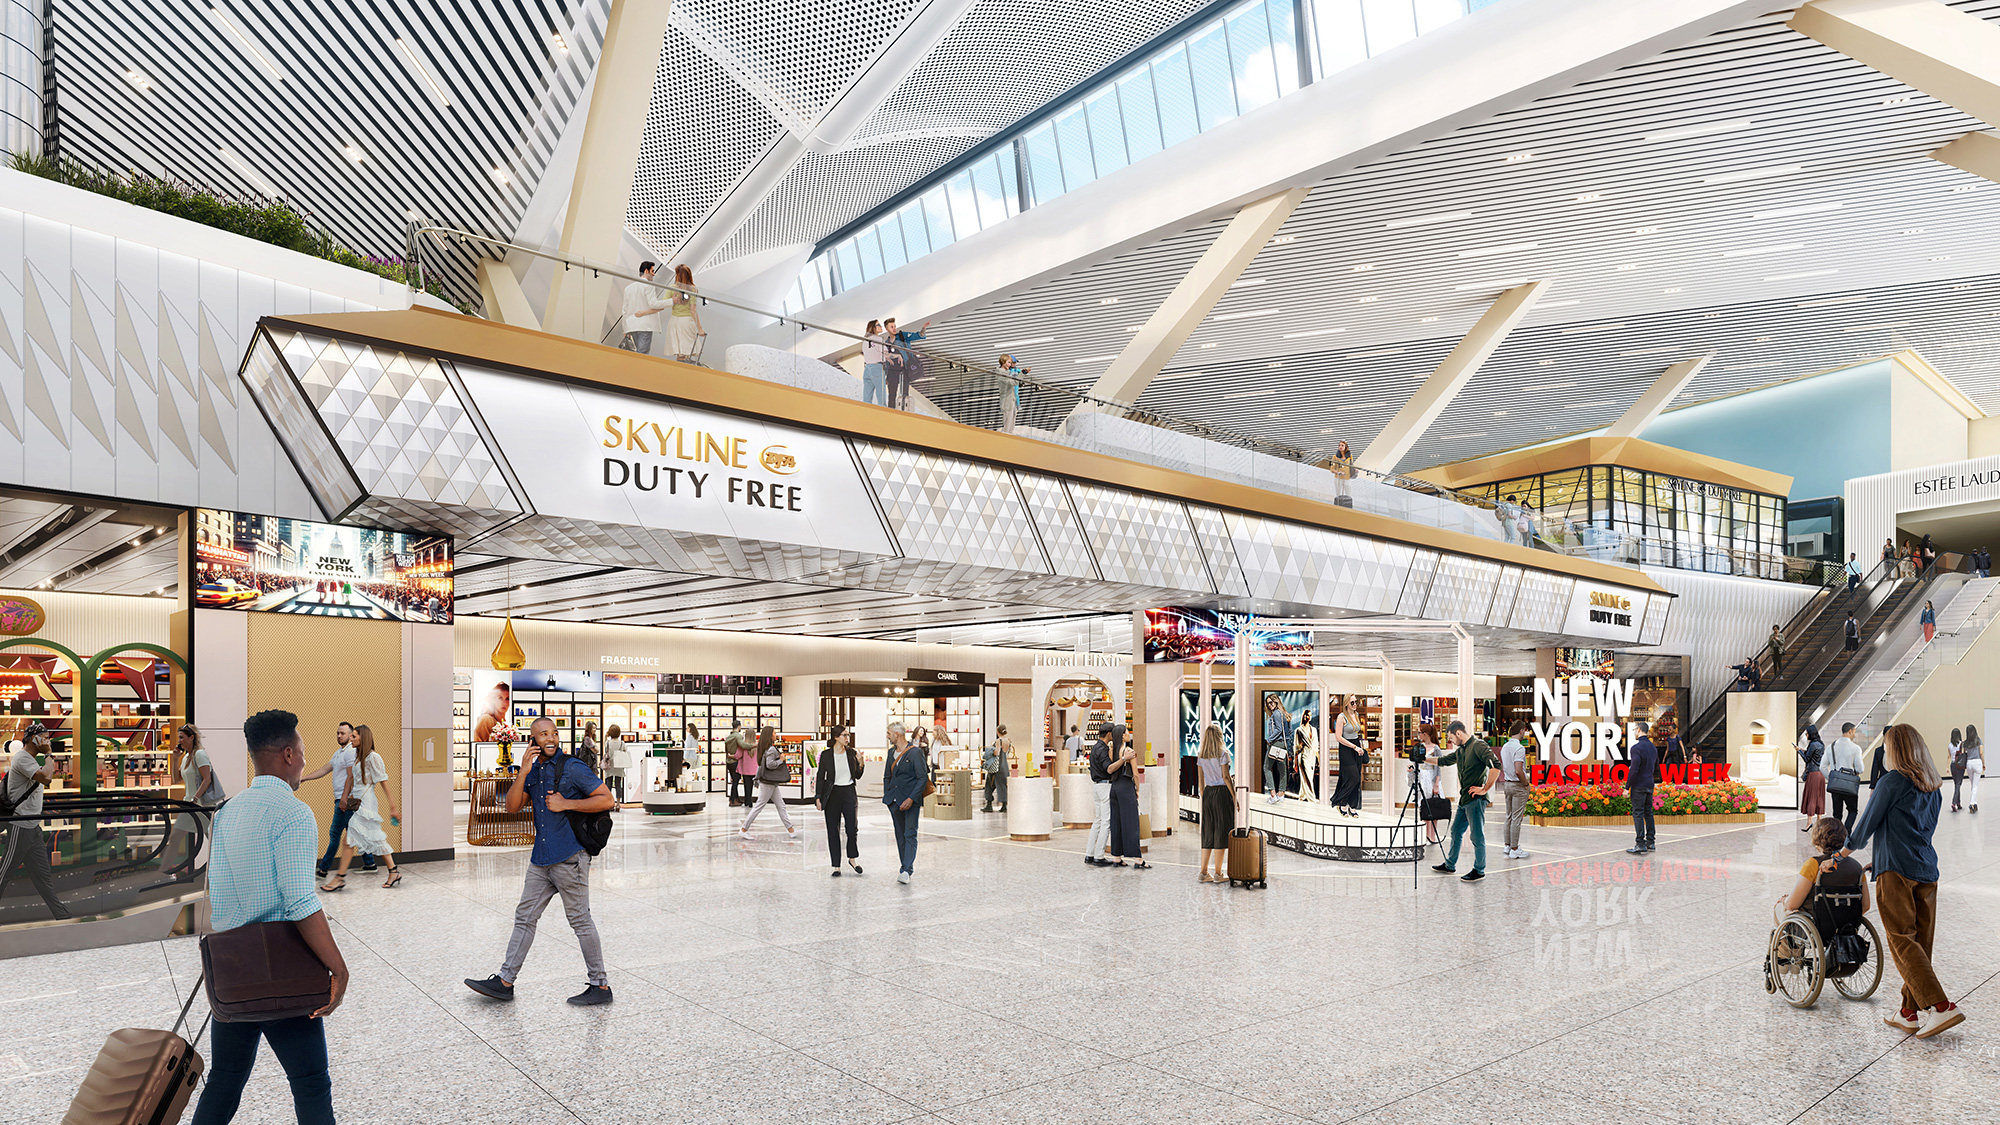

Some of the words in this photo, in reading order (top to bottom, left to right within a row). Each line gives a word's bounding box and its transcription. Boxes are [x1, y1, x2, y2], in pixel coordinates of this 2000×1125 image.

[603, 415, 747, 469] SKYLINE
[603, 457, 709, 498] DUTY
[728, 477, 802, 512] FREE
[196, 542, 248, 562] MANHATTAN
[315, 562, 355, 574] YORK
[319, 556, 351, 566] NEW
[1217, 612, 1248, 623] NEW
[1589, 609, 1613, 624] DUTY
[600, 655, 660, 666] FRAGRANCE
[937, 672, 959, 681] CHANEL
[1533, 677, 1635, 718] NEW
[1186, 705, 1233, 721] NW
[1531, 763, 1631, 788] FASHIO
[1660, 763, 1732, 786] WEEK
